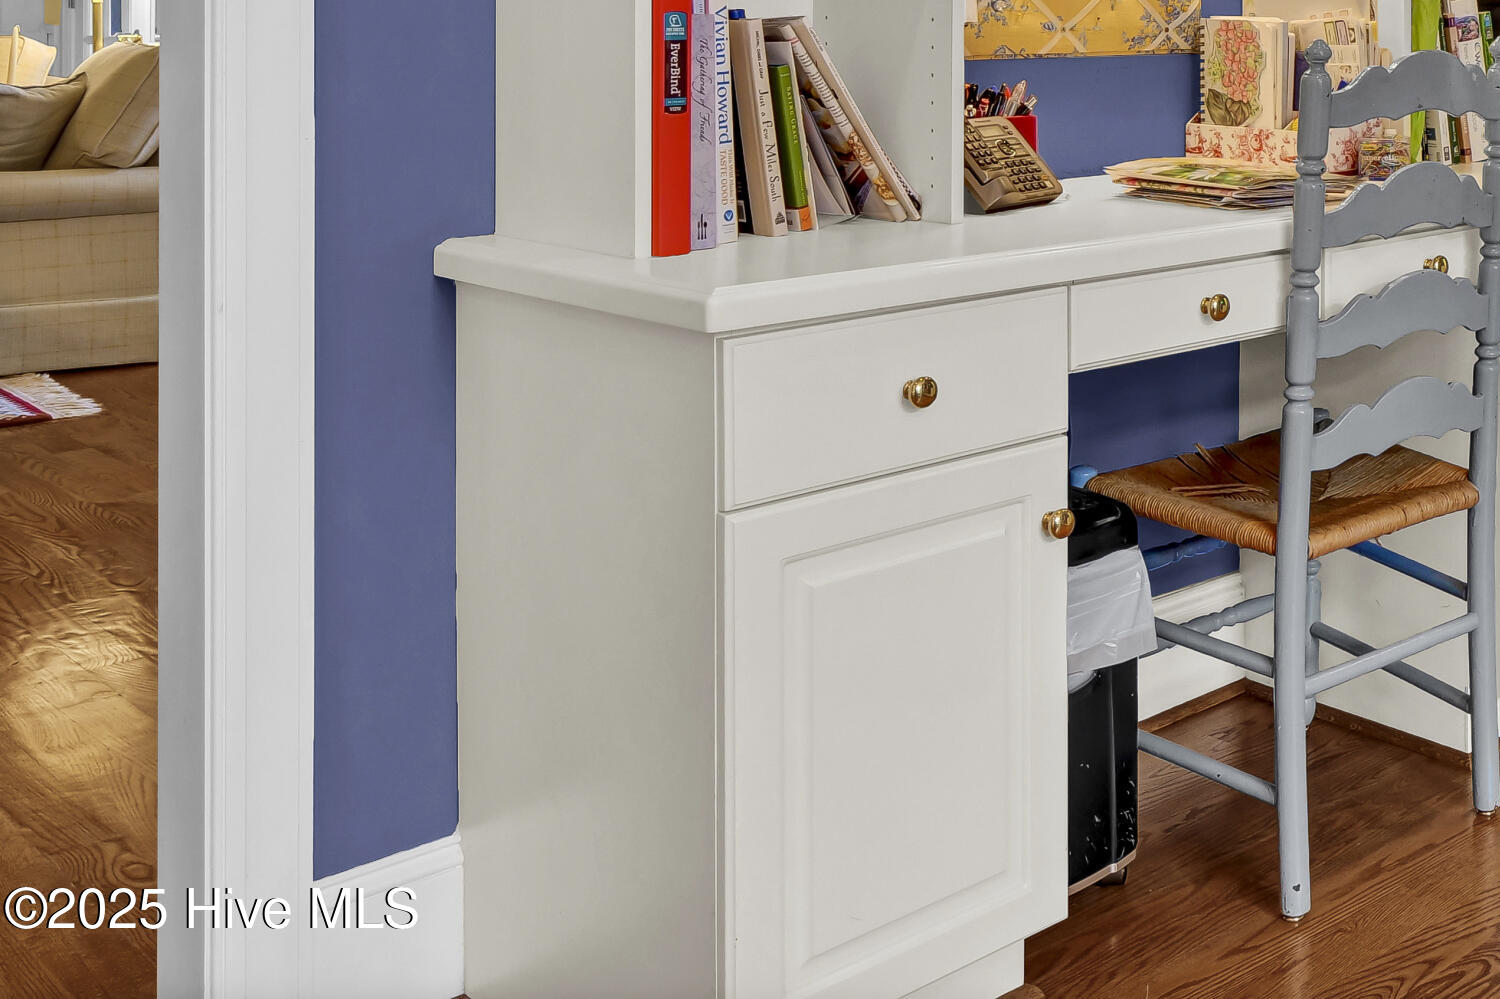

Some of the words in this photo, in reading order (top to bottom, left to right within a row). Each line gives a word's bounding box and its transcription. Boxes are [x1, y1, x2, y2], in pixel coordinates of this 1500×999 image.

[699, 38, 712, 54] The
[714, 5, 728, 65] Vivian
[669, 43, 681, 95] EverBind
[691, 56, 712, 96] Gathering
[716, 70, 733, 145] Howard
[758, 89, 769, 107] Just
[698, 112, 713, 144] Friends
[762, 119, 773, 140] Few
[719, 149, 727, 177] TASTE
[765, 143, 778, 173] Miles
[720, 178, 729, 206] GOOD
[768, 175, 780, 202] South
